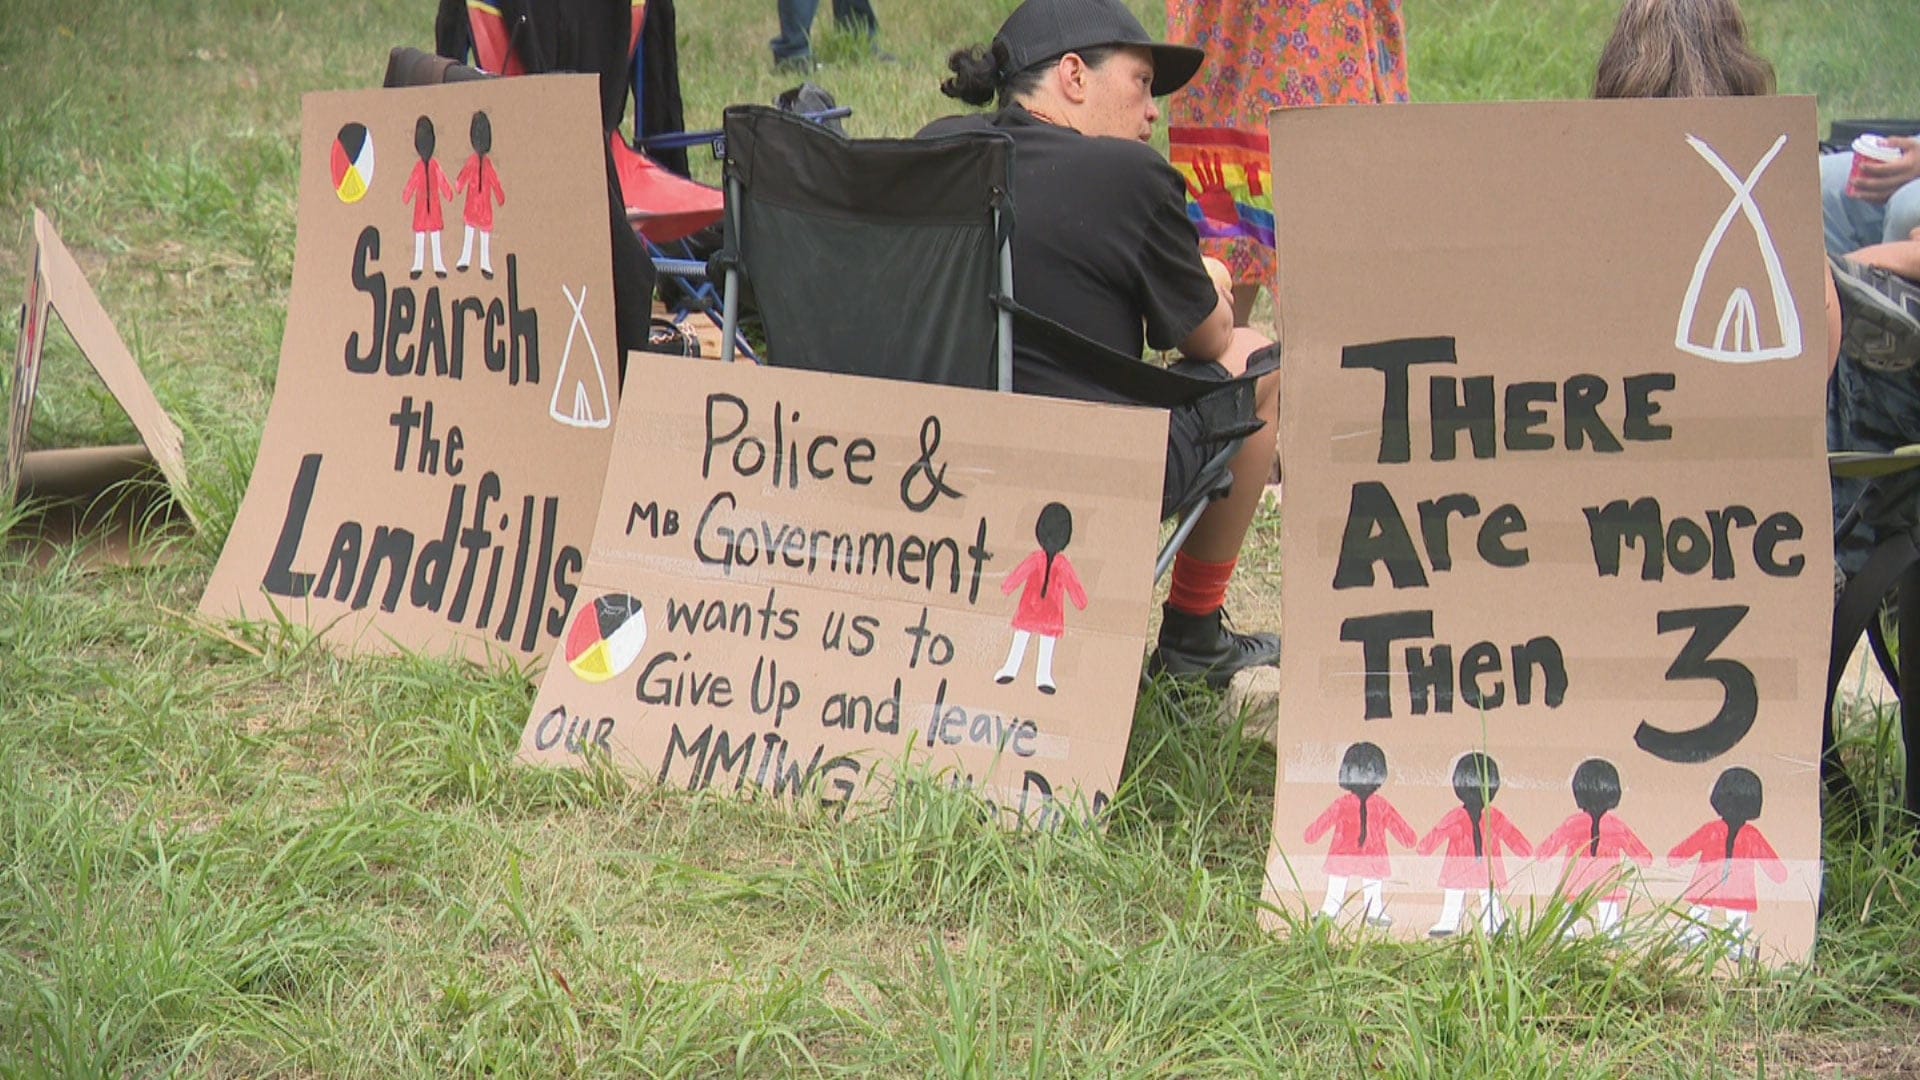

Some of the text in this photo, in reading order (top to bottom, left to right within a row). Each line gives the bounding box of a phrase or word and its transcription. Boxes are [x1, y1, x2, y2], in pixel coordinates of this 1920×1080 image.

[389, 395, 465, 477] the
[702, 392, 967, 513] Police &
[626, 491, 995, 605] MB Government
[1333, 481, 1806, 590] Are more
[667, 588, 955, 667] wants us to
[636, 651, 1039, 759] Give Up and leave
[1634, 605, 1759, 764] 3
